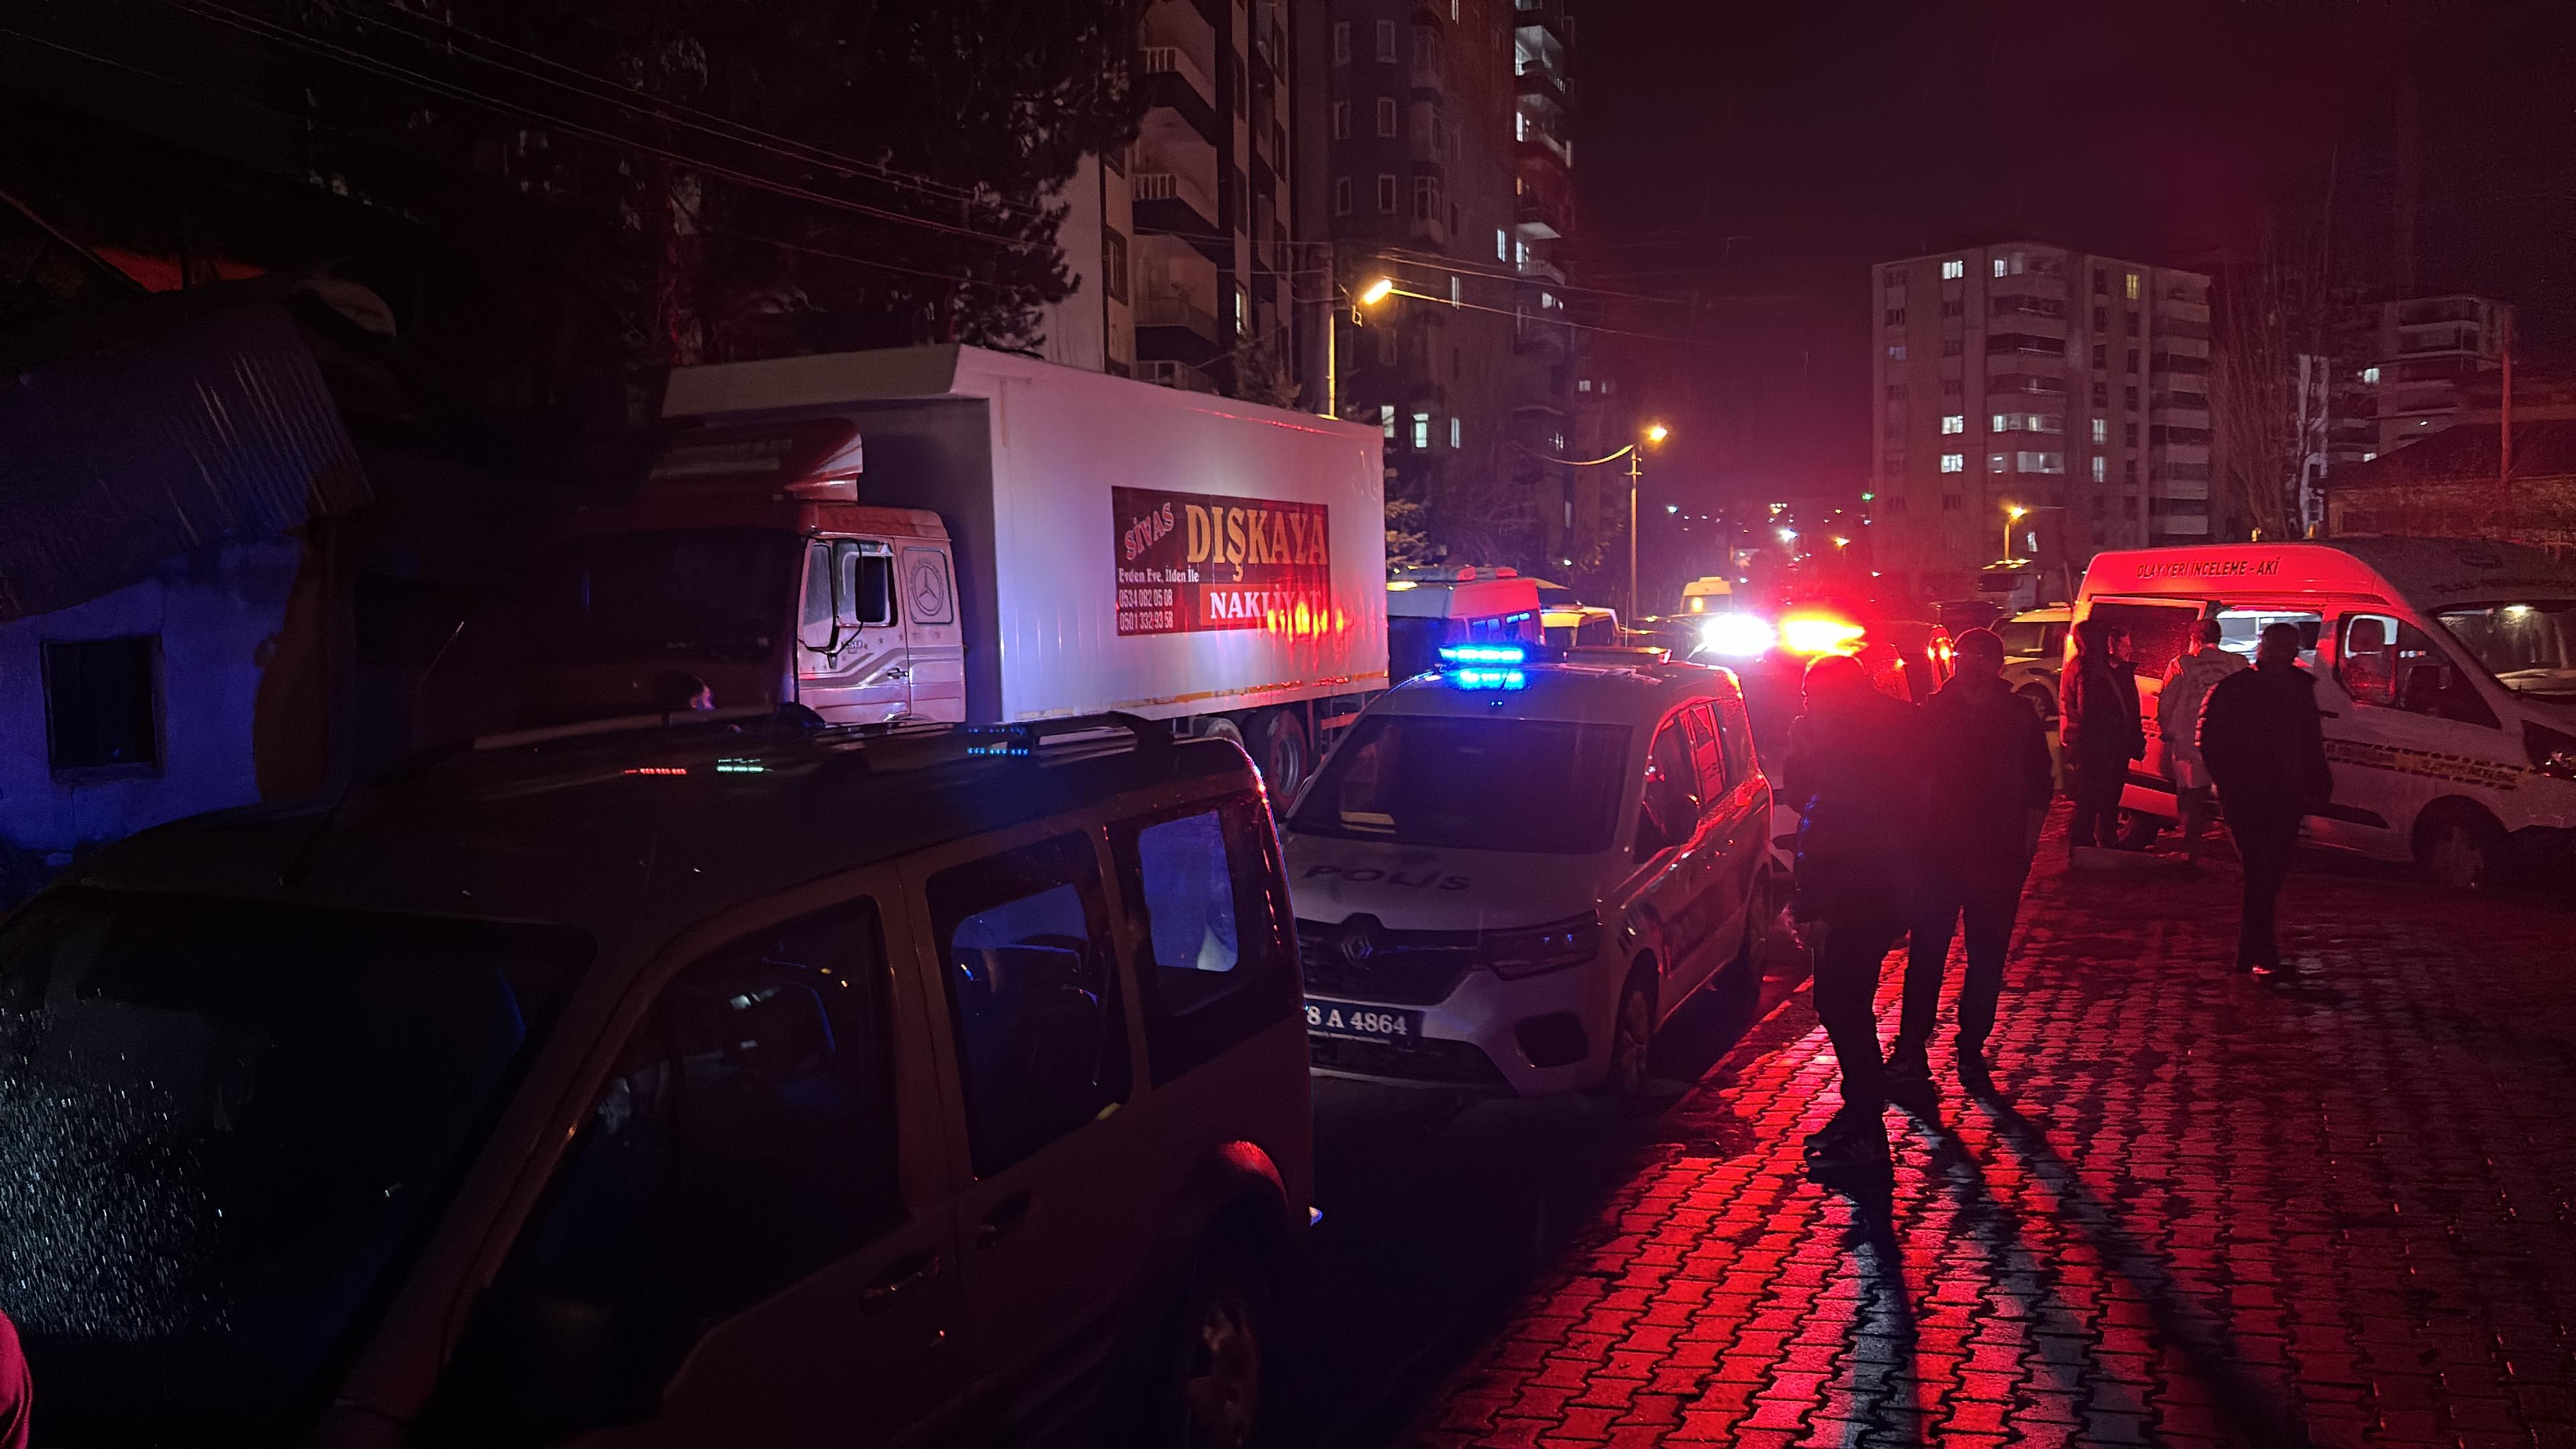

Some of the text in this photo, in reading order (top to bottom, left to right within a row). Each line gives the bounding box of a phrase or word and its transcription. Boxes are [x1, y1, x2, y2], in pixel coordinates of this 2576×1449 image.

[1124, 502, 1174, 560] SİVAS
[1185, 504, 1328, 582] DIŞKAYA
[1118, 568, 1145, 583] Evden
[2137, 564, 2165, 578] OLAY
[1305, 1005, 1408, 1035] 8 A 4864
